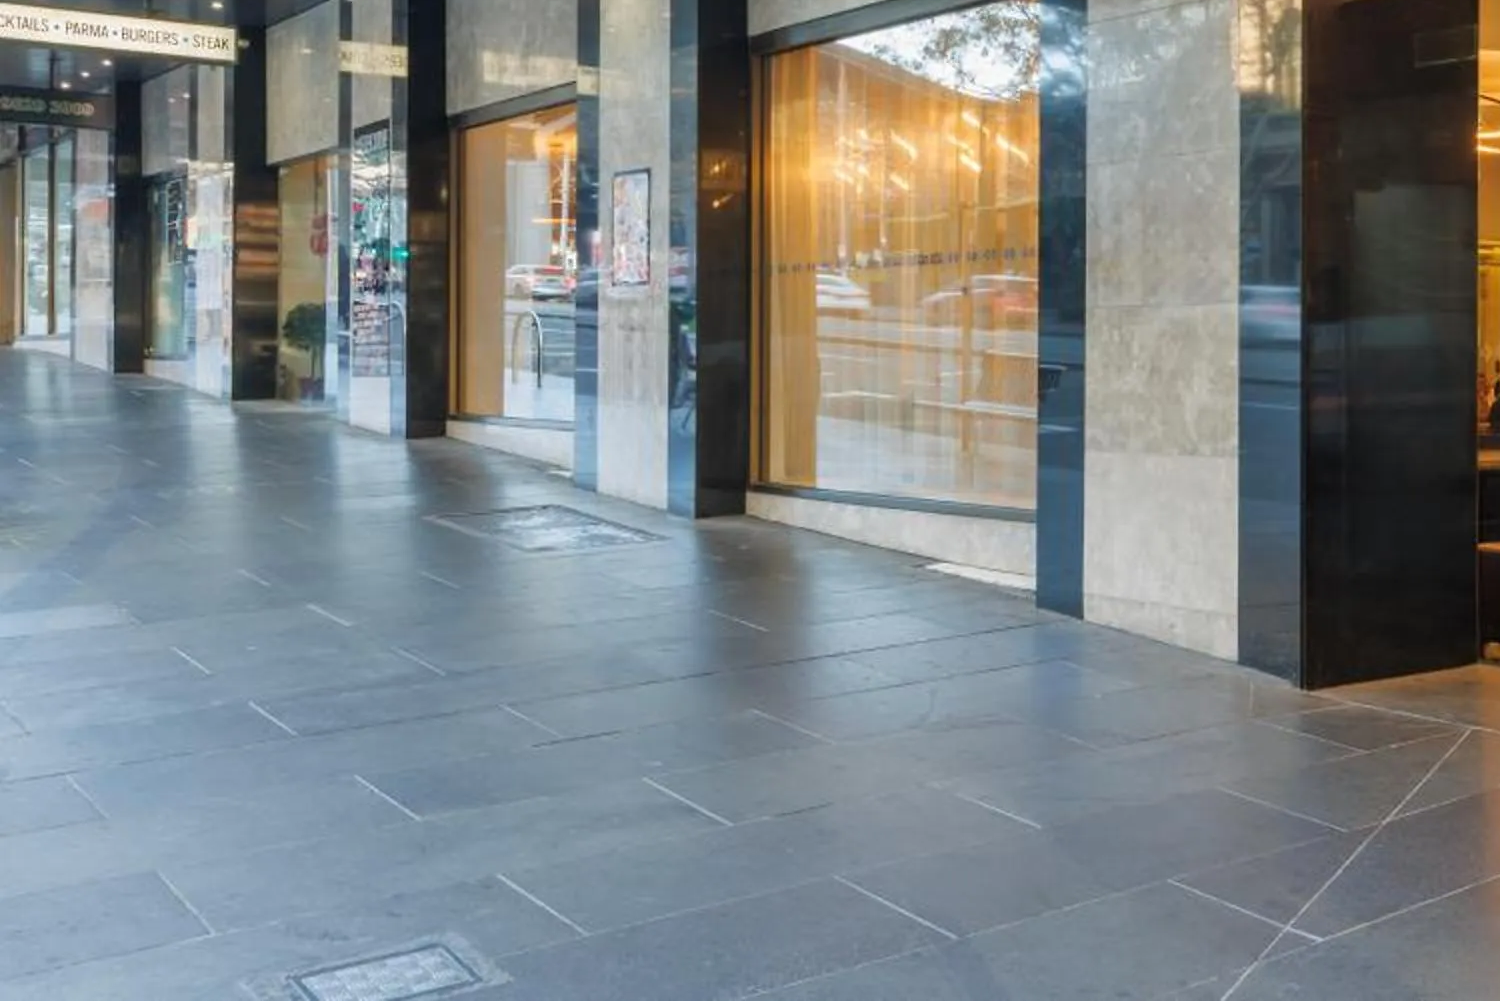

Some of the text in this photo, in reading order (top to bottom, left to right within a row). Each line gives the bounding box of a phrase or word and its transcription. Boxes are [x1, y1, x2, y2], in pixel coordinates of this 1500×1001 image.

[64, 20, 109, 39] PARMA
[121, 27, 179, 46] BURGERS
[192, 33, 230, 51] STEAK
